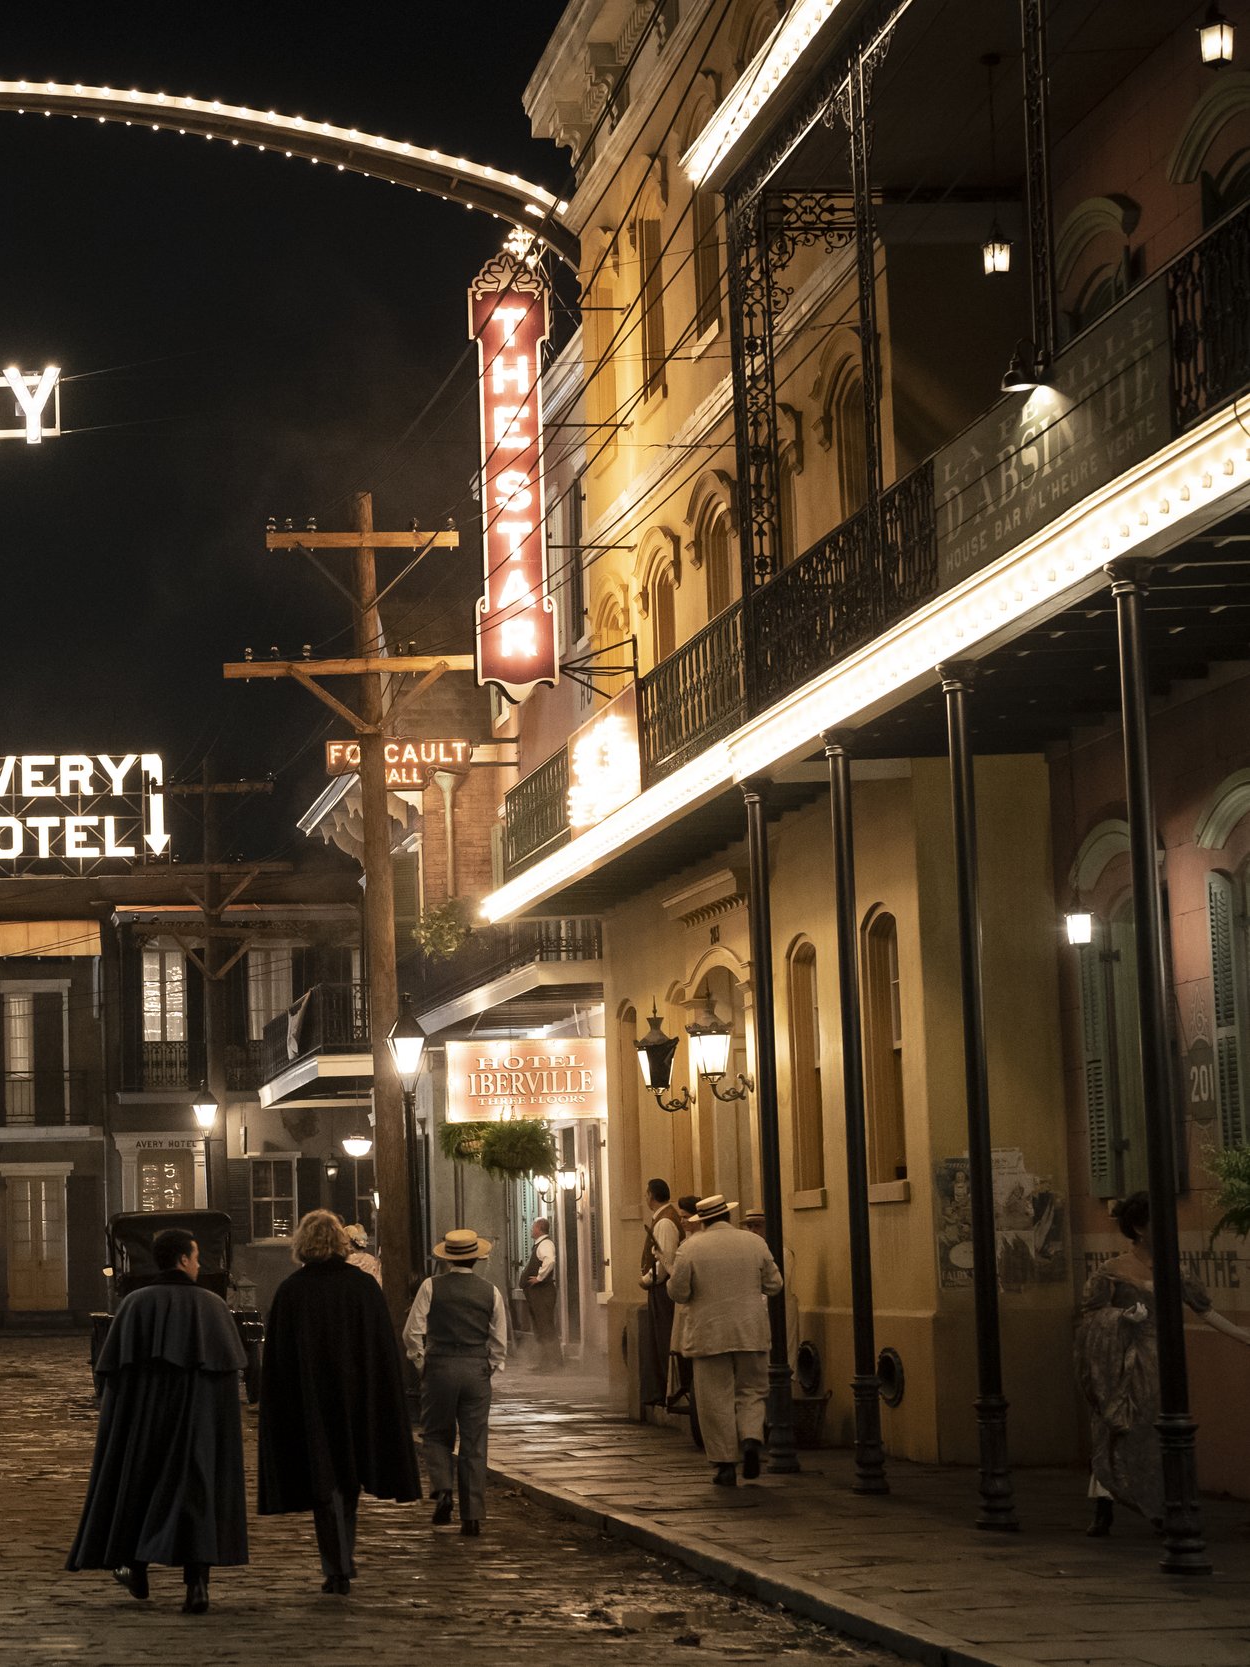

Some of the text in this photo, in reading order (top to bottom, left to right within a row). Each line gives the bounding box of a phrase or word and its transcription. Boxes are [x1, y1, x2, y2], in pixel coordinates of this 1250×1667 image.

[491, 307, 538, 657] THE STAR
[946, 530, 987, 573] HOUSE
[994, 507, 1022, 541] BAR
[1038, 456, 1099, 508] L'HEURE
[1106, 412, 1156, 462] VERTE
[329, 742, 467, 765] FOCAULT
[385, 767, 424, 784] ALL
[475, 1054, 586, 1070] HOTEL
[467, 1070, 596, 1097] IBERVILLE
[1190, 1063, 1214, 1103] 201
[477, 1094, 586, 1106] THREE FLOORS
[135, 1140, 197, 1148] AVERY HOTEL
